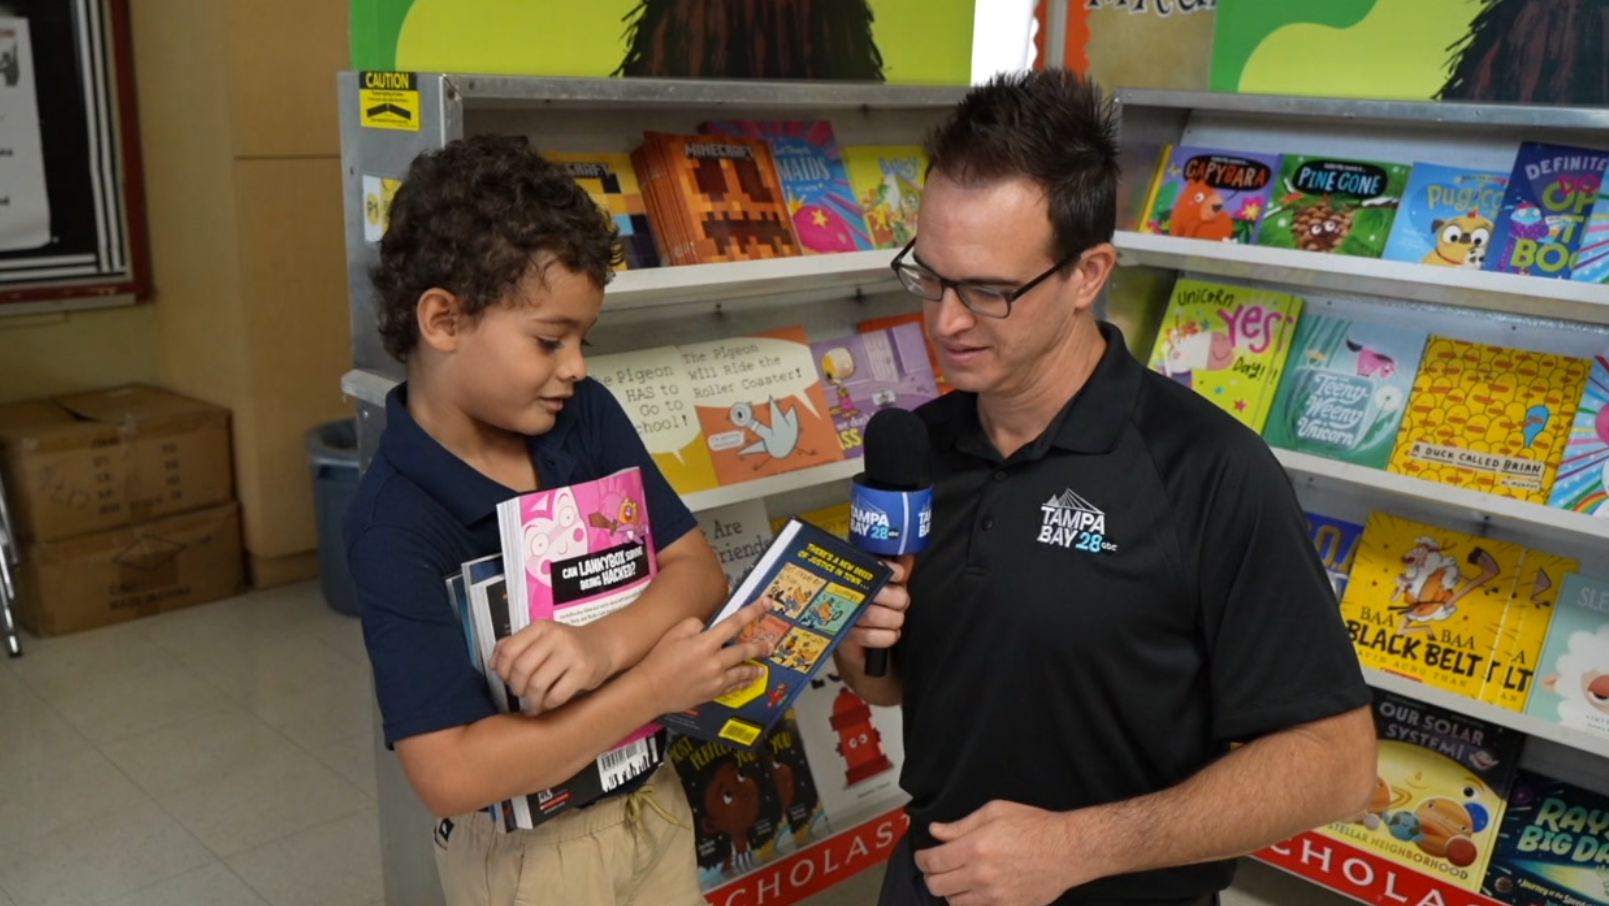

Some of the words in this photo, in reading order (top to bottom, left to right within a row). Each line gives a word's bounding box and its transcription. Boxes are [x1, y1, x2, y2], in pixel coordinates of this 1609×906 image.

[366, 72, 409, 89] CAUTION
[685, 144, 755, 159] MINECRAFT
[567, 163, 608, 178] CRAFT
[1298, 167, 1334, 191] PINE
[682, 352, 706, 364] The
[712, 344, 759, 360] Pigeon
[723, 361, 754, 376] Ride
[759, 355, 781, 368] the
[616, 366, 674, 384] Pigeon
[693, 383, 734, 399] Roller
[741, 368, 802, 390] Coaster!
[626, 386, 655, 402] HAS
[661, 385, 679, 396] to
[636, 415, 688, 433] chool!
[1305, 396, 1363, 429] Weeny
[1297, 417, 1354, 445] Unicorn
[1412, 444, 1420, 453] A
[1425, 447, 1454, 459] DUCK
[1459, 452, 1499, 468] CALLED
[1503, 460, 1542, 474] BRIAN
[714, 519, 742, 539] Are
[871, 526, 889, 540] 28
[1041, 506, 1105, 535] TAMPA
[711, 534, 768, 563] riend
[1037, 525, 1078, 548] BAY
[1076, 531, 1102, 552] 28
[562, 566, 579, 580] CAN
[578, 550, 626, 575] LANKYBOX
[798, 549, 809, 559] OF
[808, 556, 835, 572] JUSTICE
[833, 568, 843, 576] IN
[832, 556, 840, 564] A
[840, 559, 854, 571] NEW
[1360, 606, 1394, 628] BAA
[1347, 619, 1421, 661] BLACK
[1424, 643, 1483, 677] BELT
[1440, 629, 1475, 650] BAA
[1358, 650, 1388, 664] AVIN
[1393, 661, 1426, 676] AUNG
[1434, 672, 1467, 688] THAN
[1380, 702, 1420, 725] OUR
[1423, 715, 1484, 746] SOLAR
[1386, 723, 1464, 760] SYSTEM!
[1534, 798, 1609, 840] RAY
[1327, 822, 1369, 843] STELLAR
[1370, 838, 1469, 881] NEIGHBORHOOD
[1517, 825, 1573, 855] BIG
[709, 813, 910, 906] CHOLAS
[1270, 839, 1495, 906] HOLA
